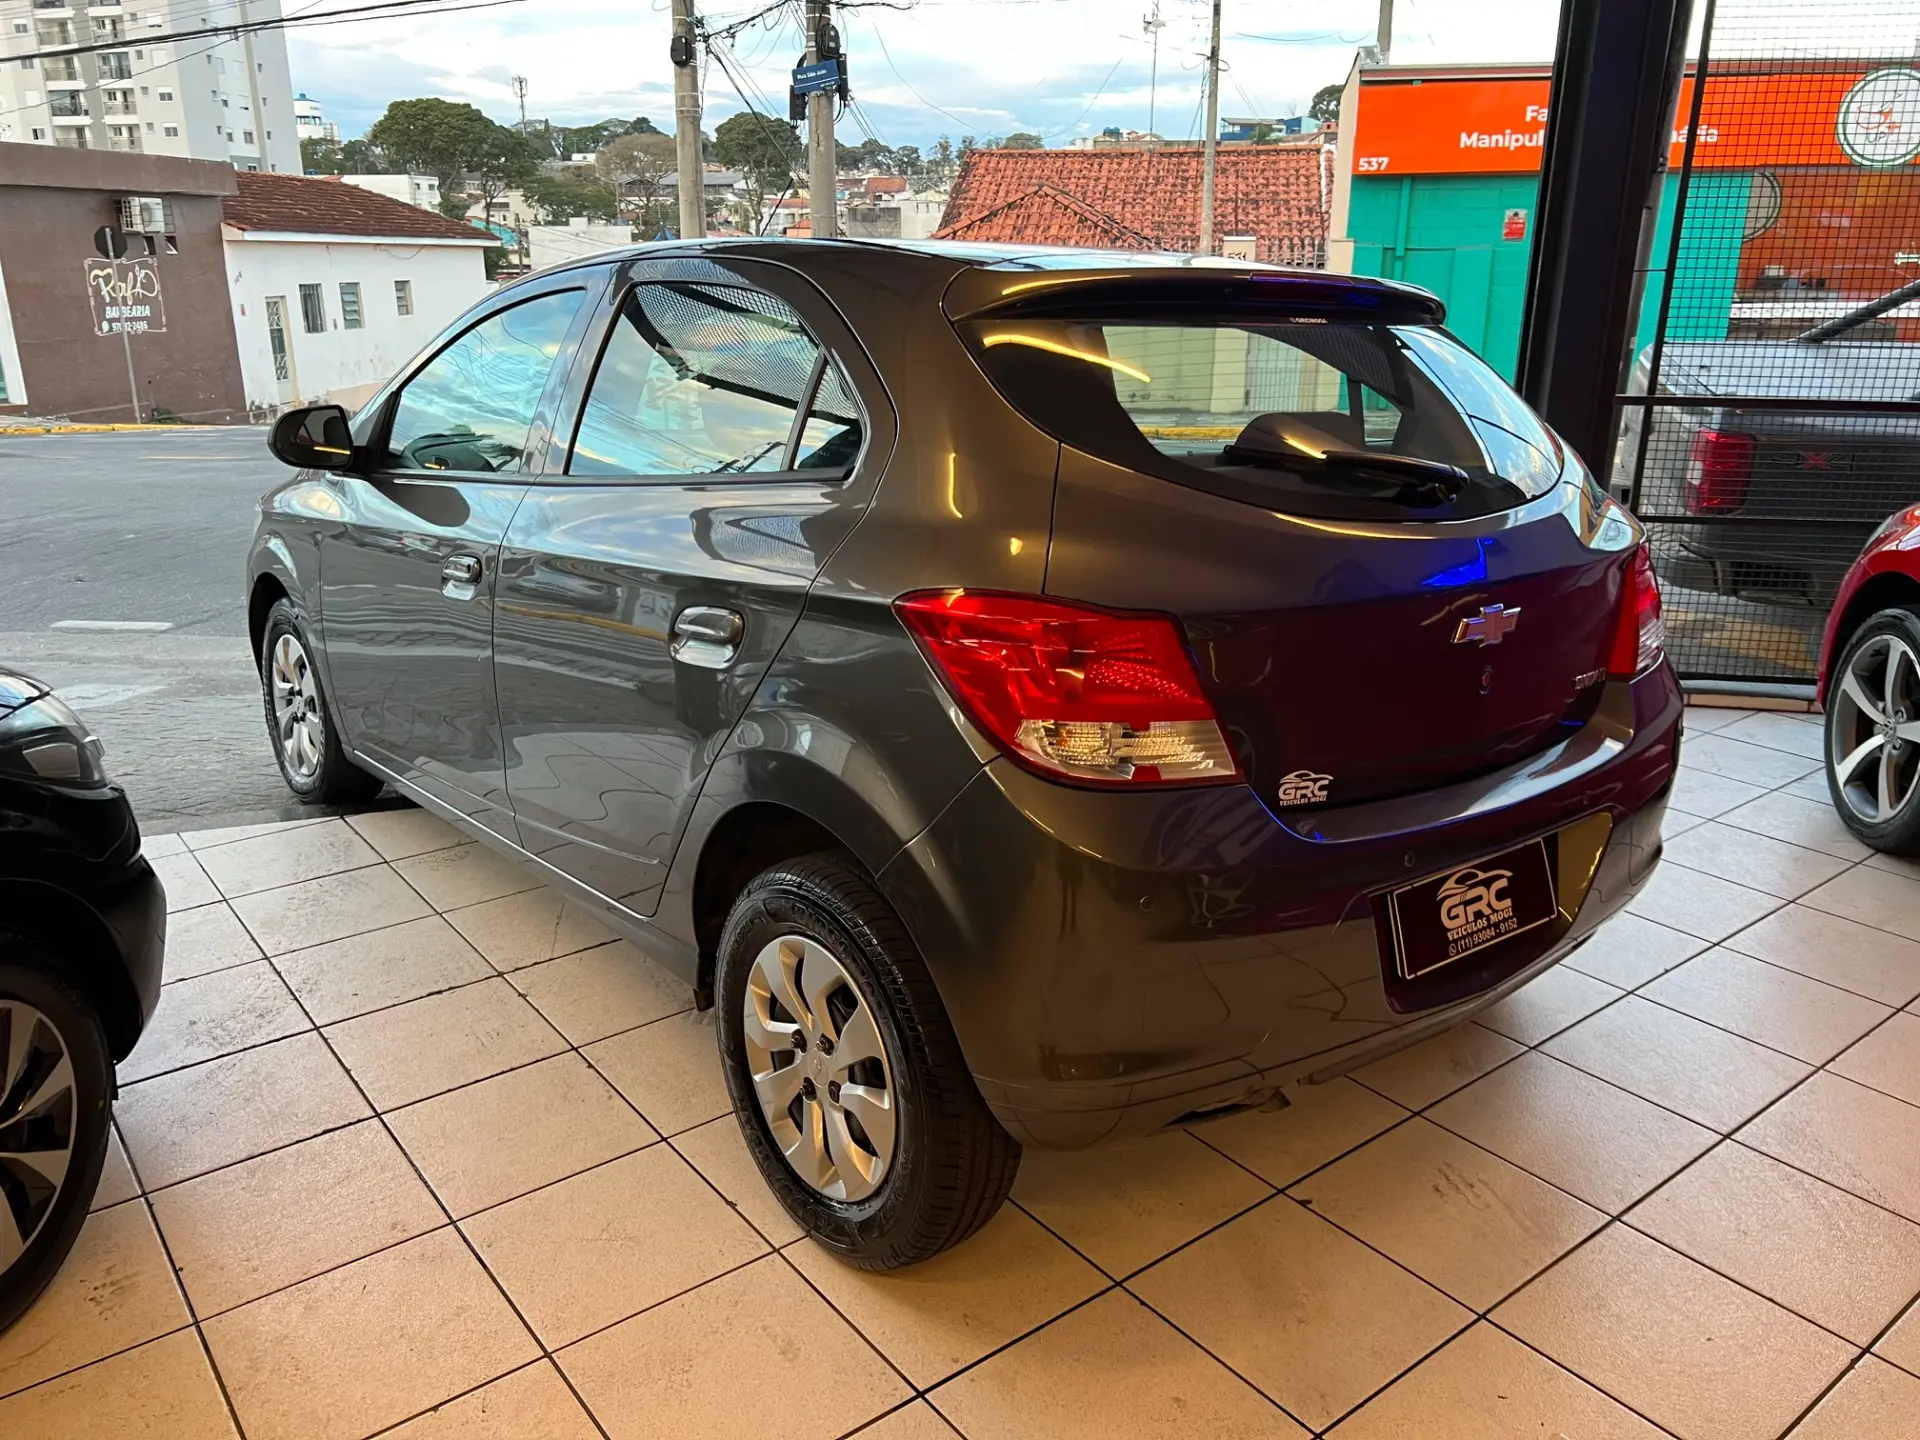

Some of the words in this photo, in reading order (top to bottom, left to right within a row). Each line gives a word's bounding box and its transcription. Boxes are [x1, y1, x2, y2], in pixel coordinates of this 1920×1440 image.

[1525, 105, 1548, 122] Fa
[1460, 129, 1545, 151] Manipul
[1358, 157, 1390, 171] 537
[1278, 779, 1330, 800] GRC
[1280, 797, 1309, 807] VEICULOS
[1441, 878, 1512, 929] GRC
[1446, 917, 1488, 941] VEICULOS
[1490, 908, 1513, 925] MOGI
